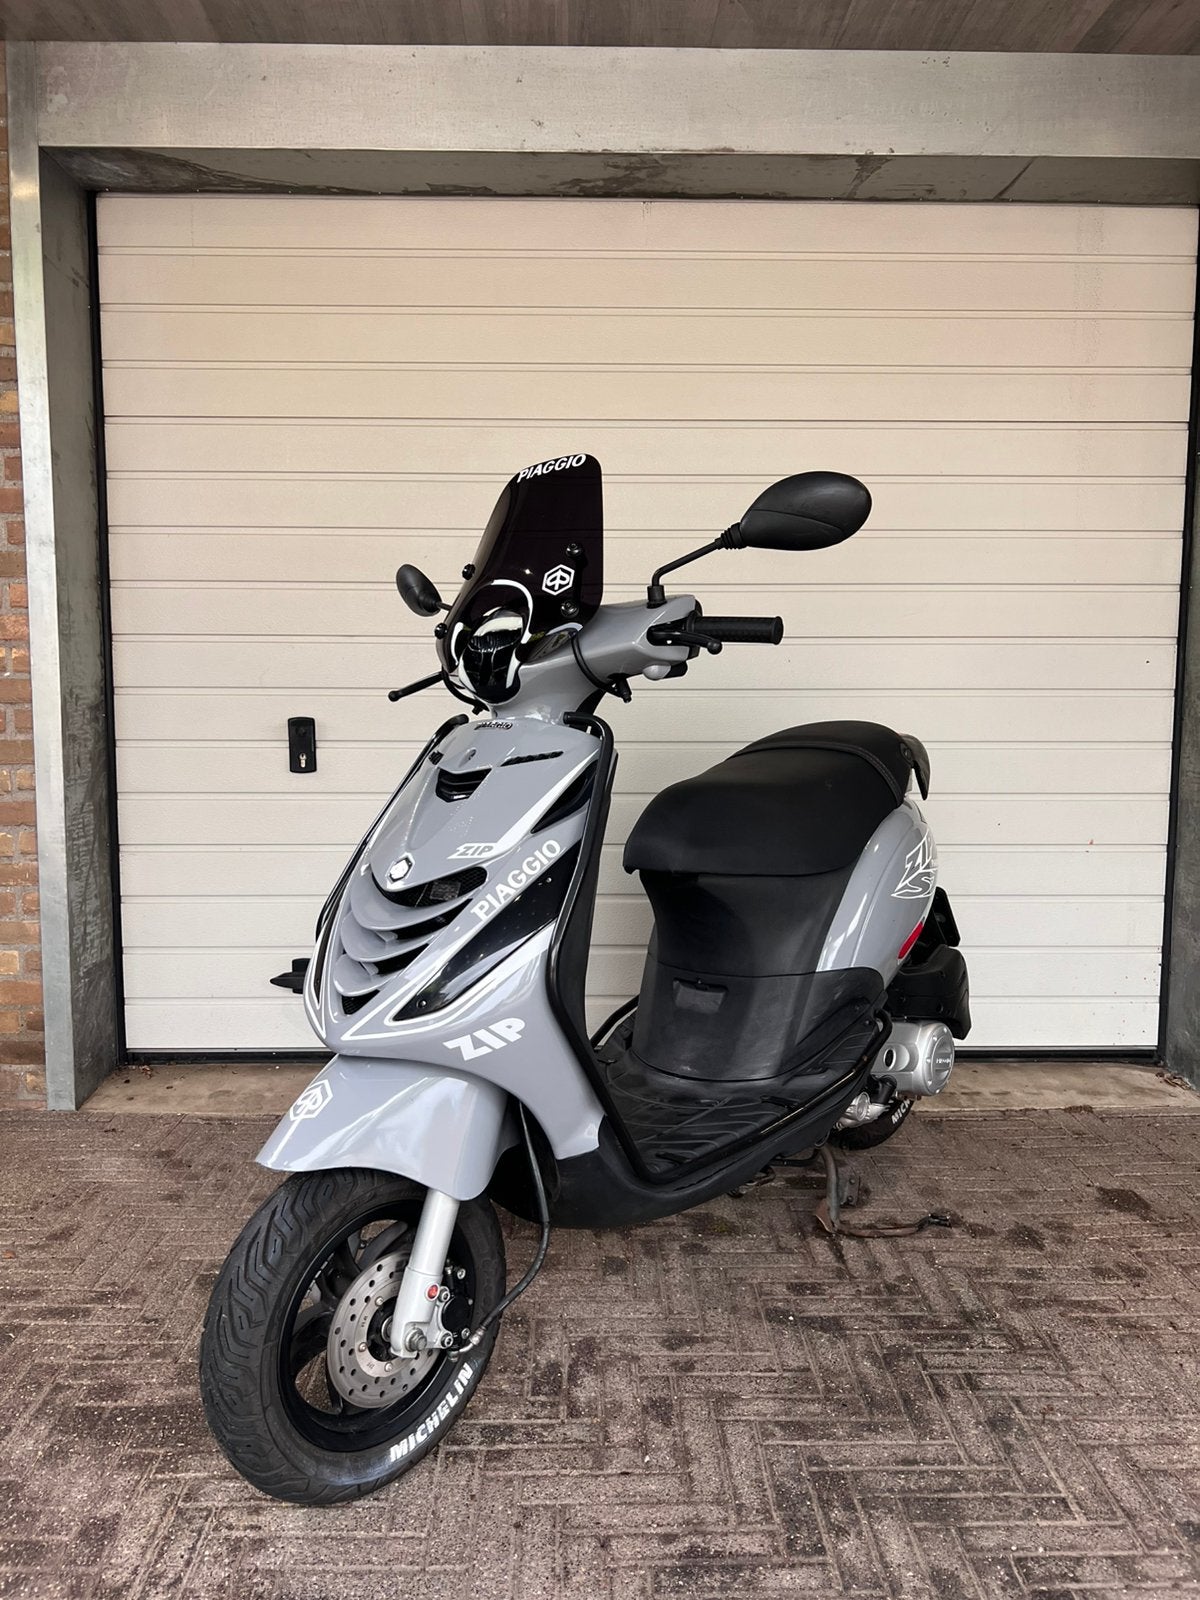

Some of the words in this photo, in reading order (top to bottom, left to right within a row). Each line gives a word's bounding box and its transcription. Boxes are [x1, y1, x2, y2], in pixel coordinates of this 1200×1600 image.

[516, 453, 587, 483] PIAGGIO
[457, 845, 494, 857] ZIP
[470, 840, 561, 921] PIAGGIO
[442, 1017, 526, 1062] ZIP
[891, 1099, 910, 1124] MICH
[389, 1362, 474, 1462] MICHELIN
